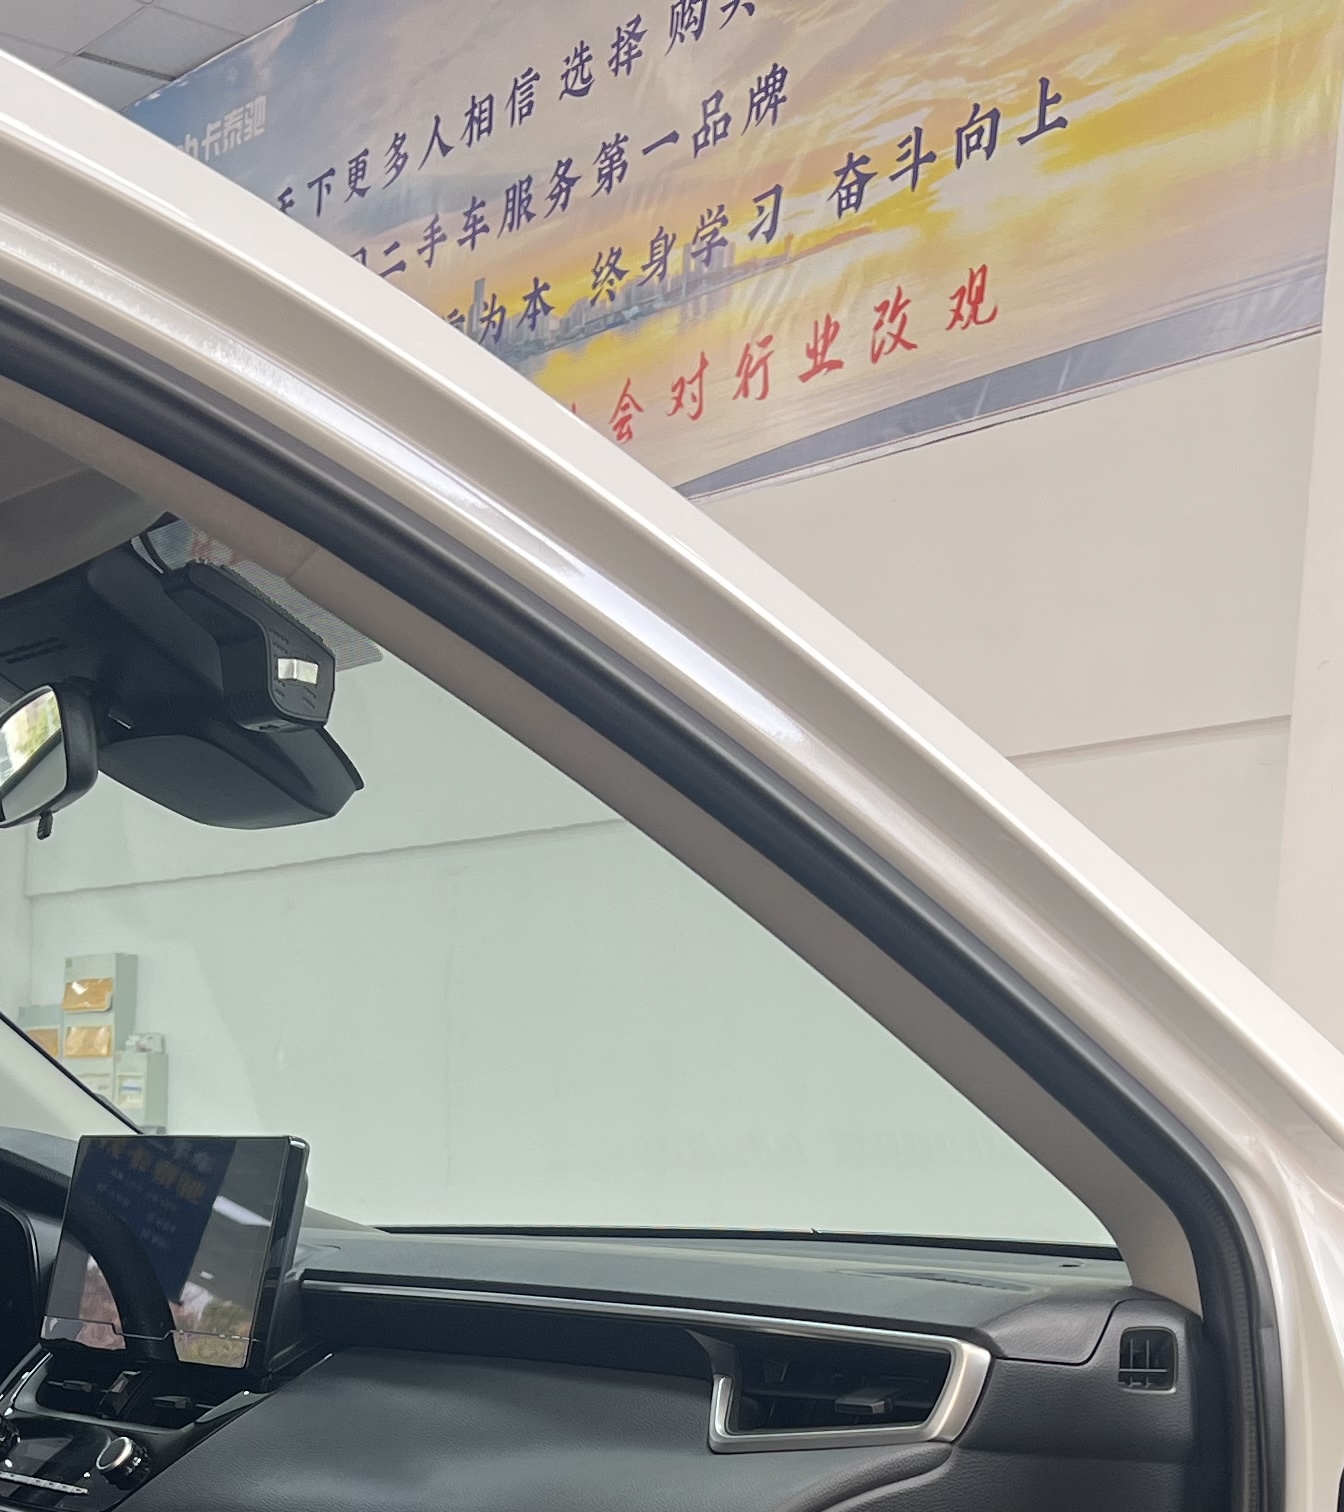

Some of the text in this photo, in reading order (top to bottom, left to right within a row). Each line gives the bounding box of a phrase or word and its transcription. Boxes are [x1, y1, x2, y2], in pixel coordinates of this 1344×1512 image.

[590, 184, 783, 307] 终身学习
[828, 77, 1068, 219] 奋斗向上
[569, 264, 998, 445] 会对行业改观
